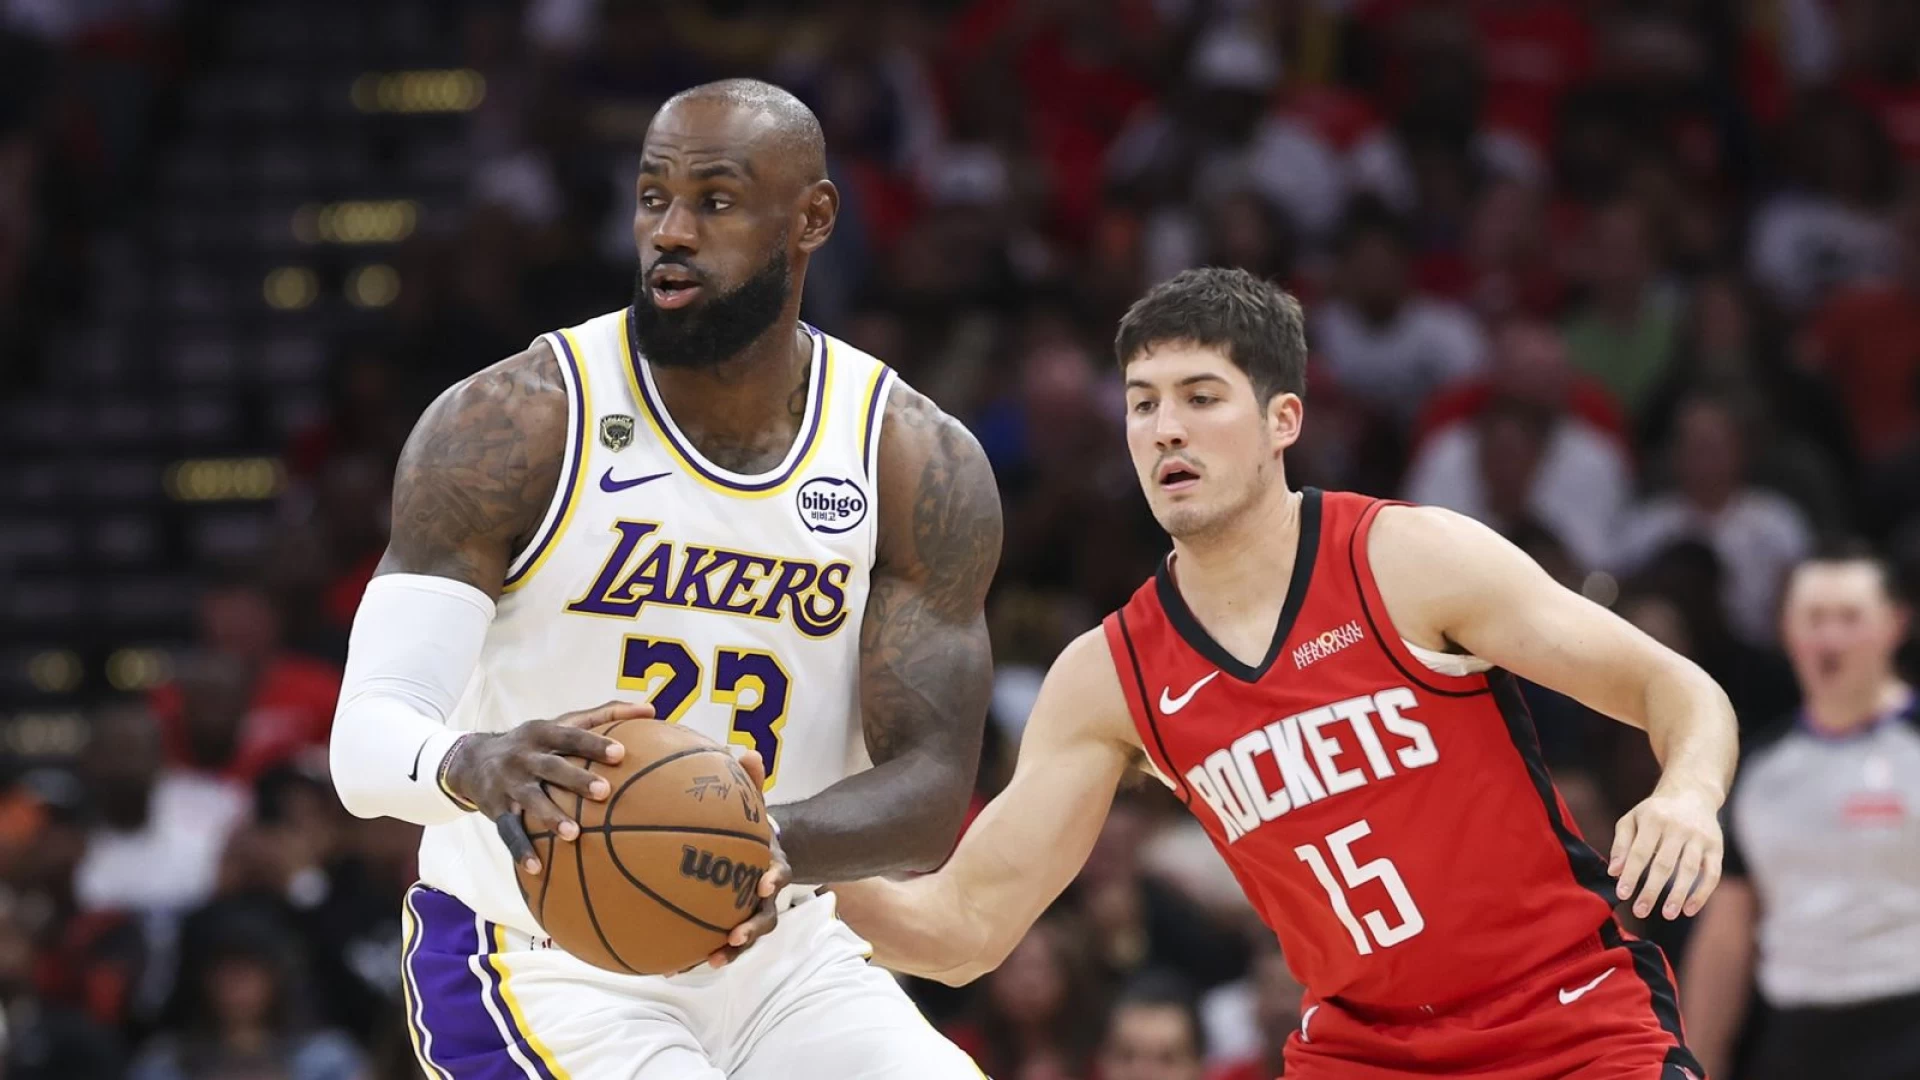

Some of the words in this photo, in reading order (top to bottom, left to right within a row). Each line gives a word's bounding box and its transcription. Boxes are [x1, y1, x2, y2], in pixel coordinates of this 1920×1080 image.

[802, 490, 863, 518] bibigo
[811, 511, 836, 521] 비비고
[562, 518, 853, 640] LAKERS
[1292, 620, 1361, 657] MEMORIAL
[1295, 628, 1364, 670] HERMANN
[616, 633, 793, 792] 23
[1185, 687, 1439, 844] ROCKETS
[1294, 819, 1424, 955] 15
